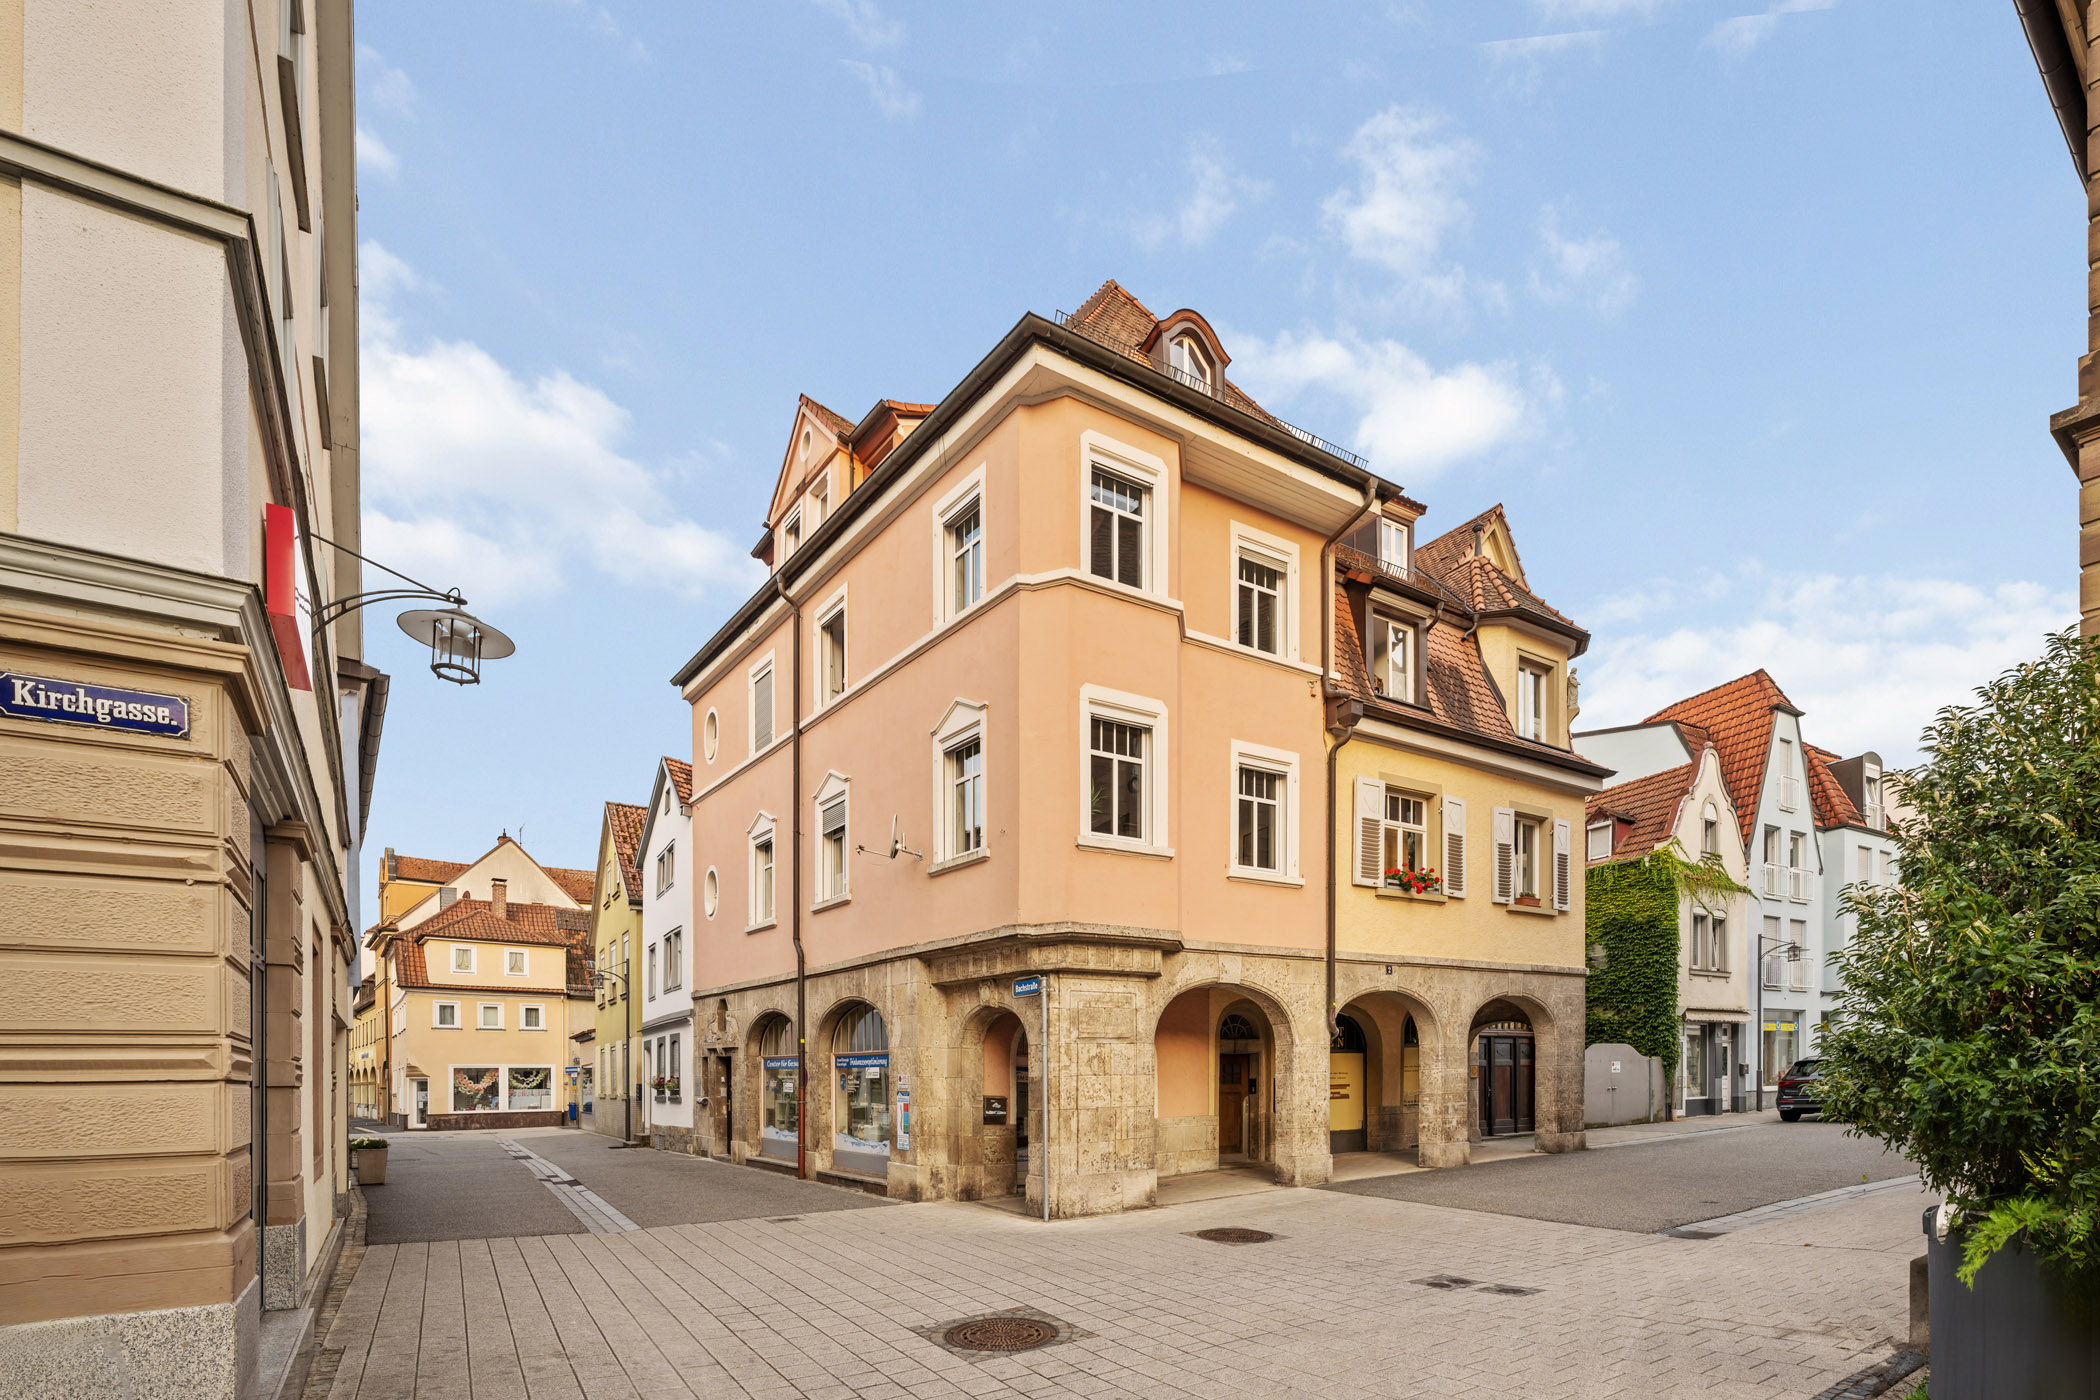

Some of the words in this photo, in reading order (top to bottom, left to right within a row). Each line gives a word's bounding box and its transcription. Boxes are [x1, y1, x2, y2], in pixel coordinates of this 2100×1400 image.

[11, 679, 178, 726] Kirchgasse.
[1015, 982, 1038, 993] Bachstraße
[766, 1060, 780, 1068] Center
